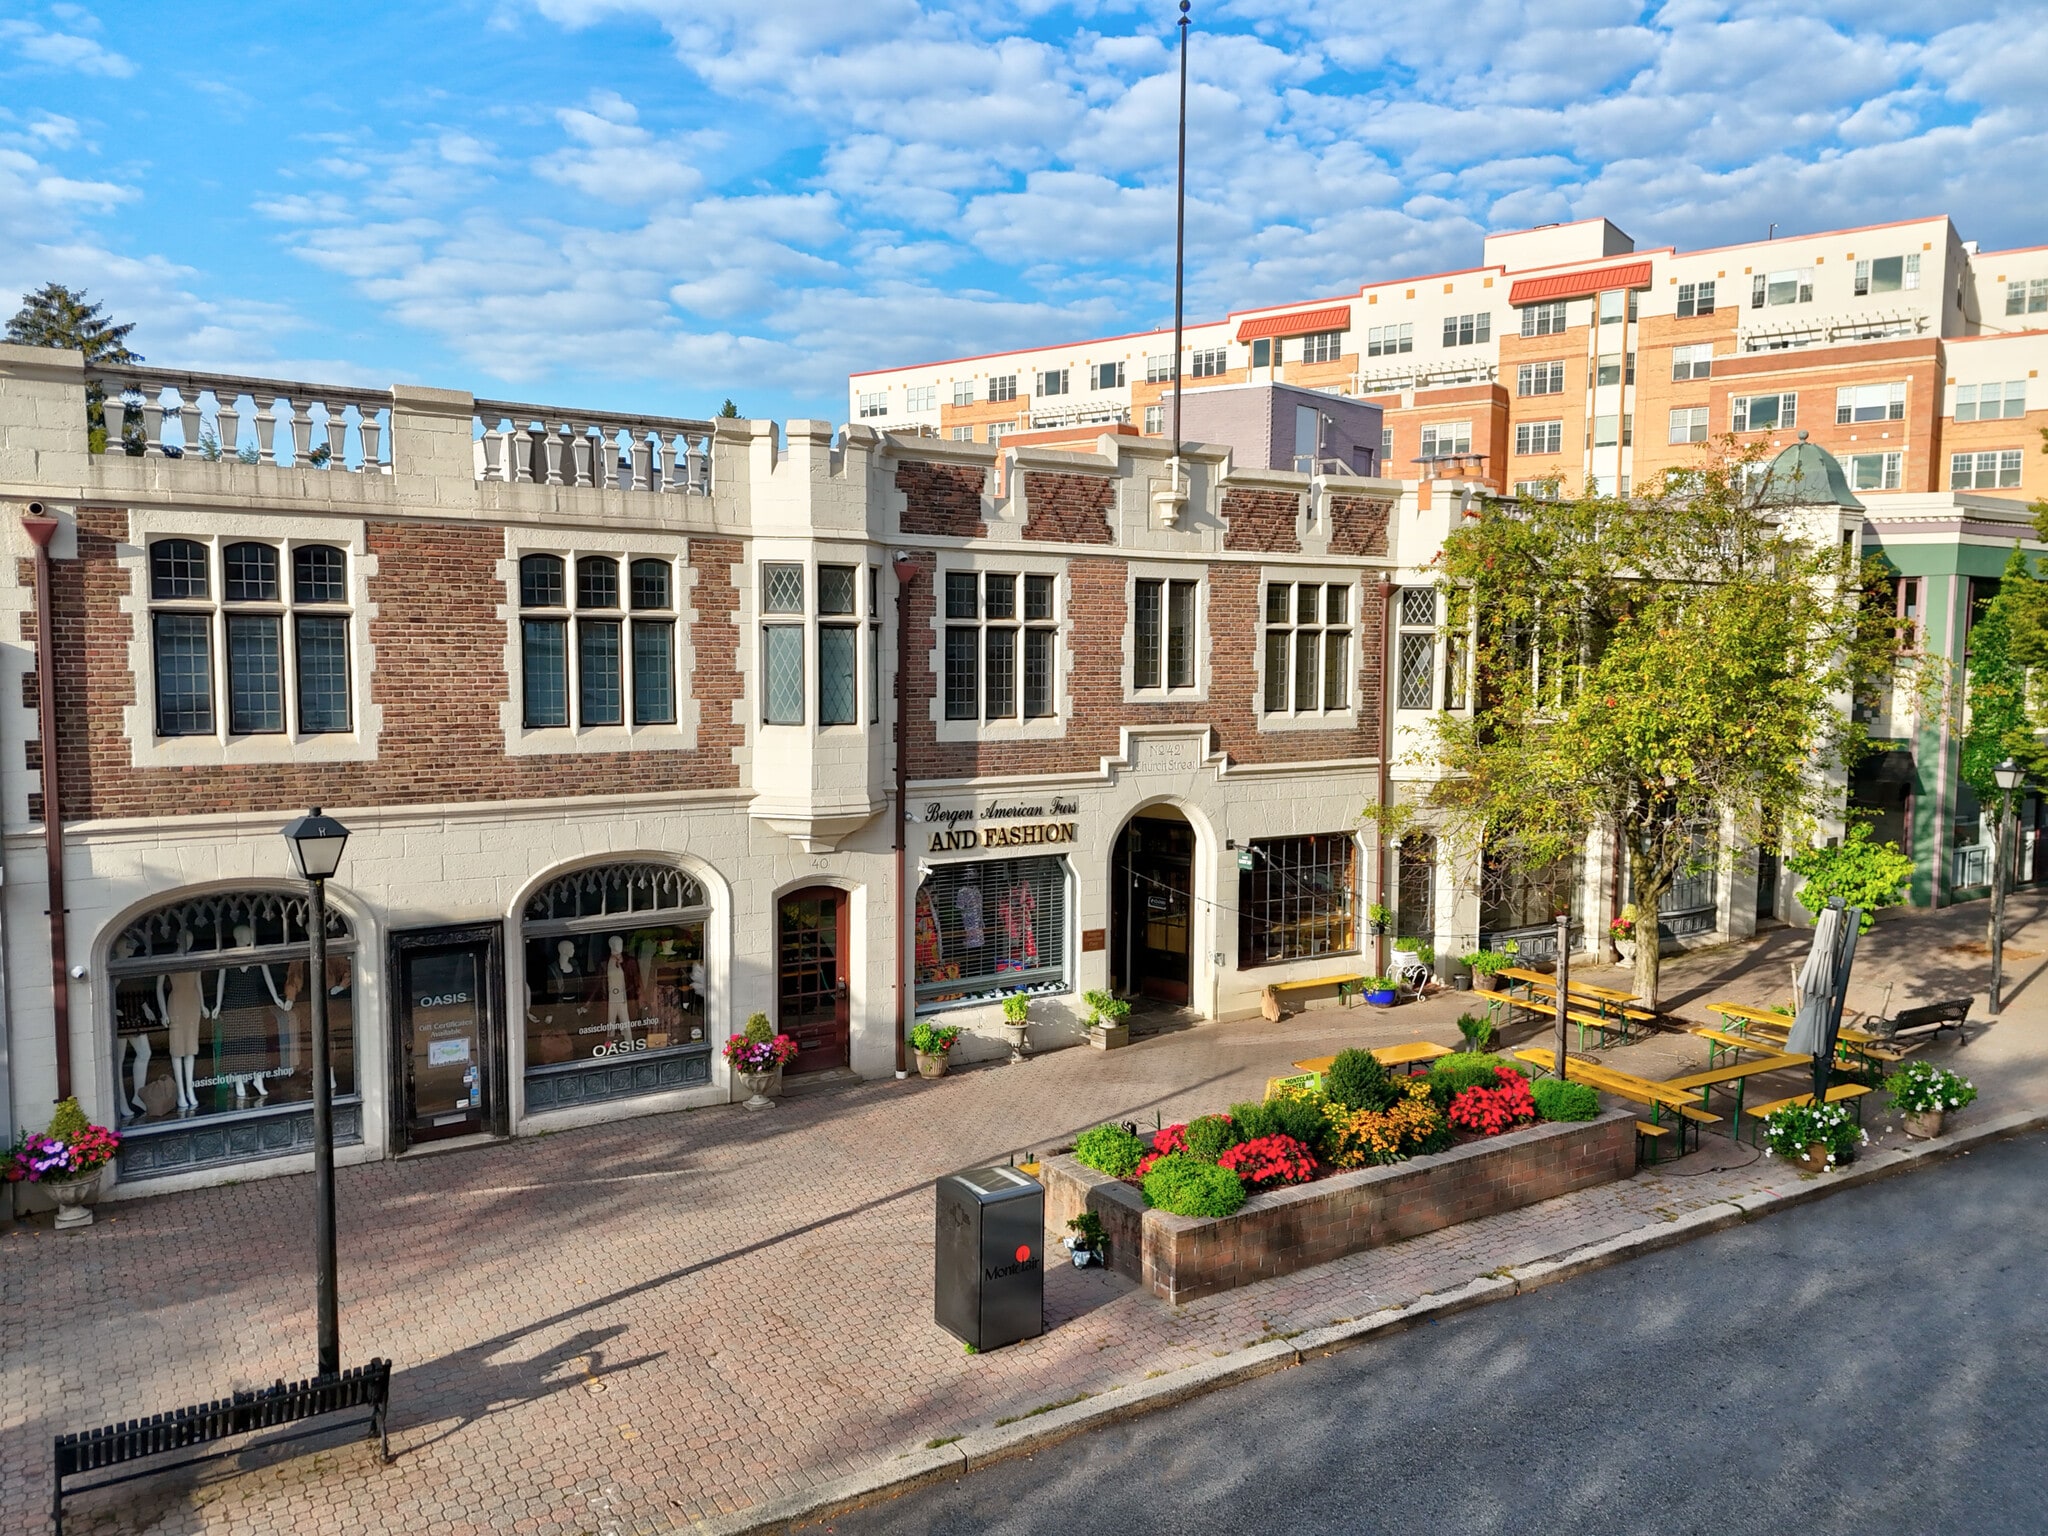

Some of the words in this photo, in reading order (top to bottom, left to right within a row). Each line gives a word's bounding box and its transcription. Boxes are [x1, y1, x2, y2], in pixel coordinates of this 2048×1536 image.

[1135, 761, 1167, 773] Church
[1168, 760, 1195, 771] Street
[925, 802, 973, 829] Bergen
[980, 799, 1043, 819] American
[1050, 796, 1077, 815] Furs
[929, 829, 977, 852] AND
[984, 822, 1075, 848] FASHION
[812, 858, 829, 869] 40
[420, 992, 467, 1008] OASIS
[578, 1017, 659, 1035] oasisclothingstore.shop
[592, 1038, 647, 1057] OASIS
[1285, 1074, 1314, 1084] MONTCLAIR
[985, 1256, 1040, 1281] Montclair
